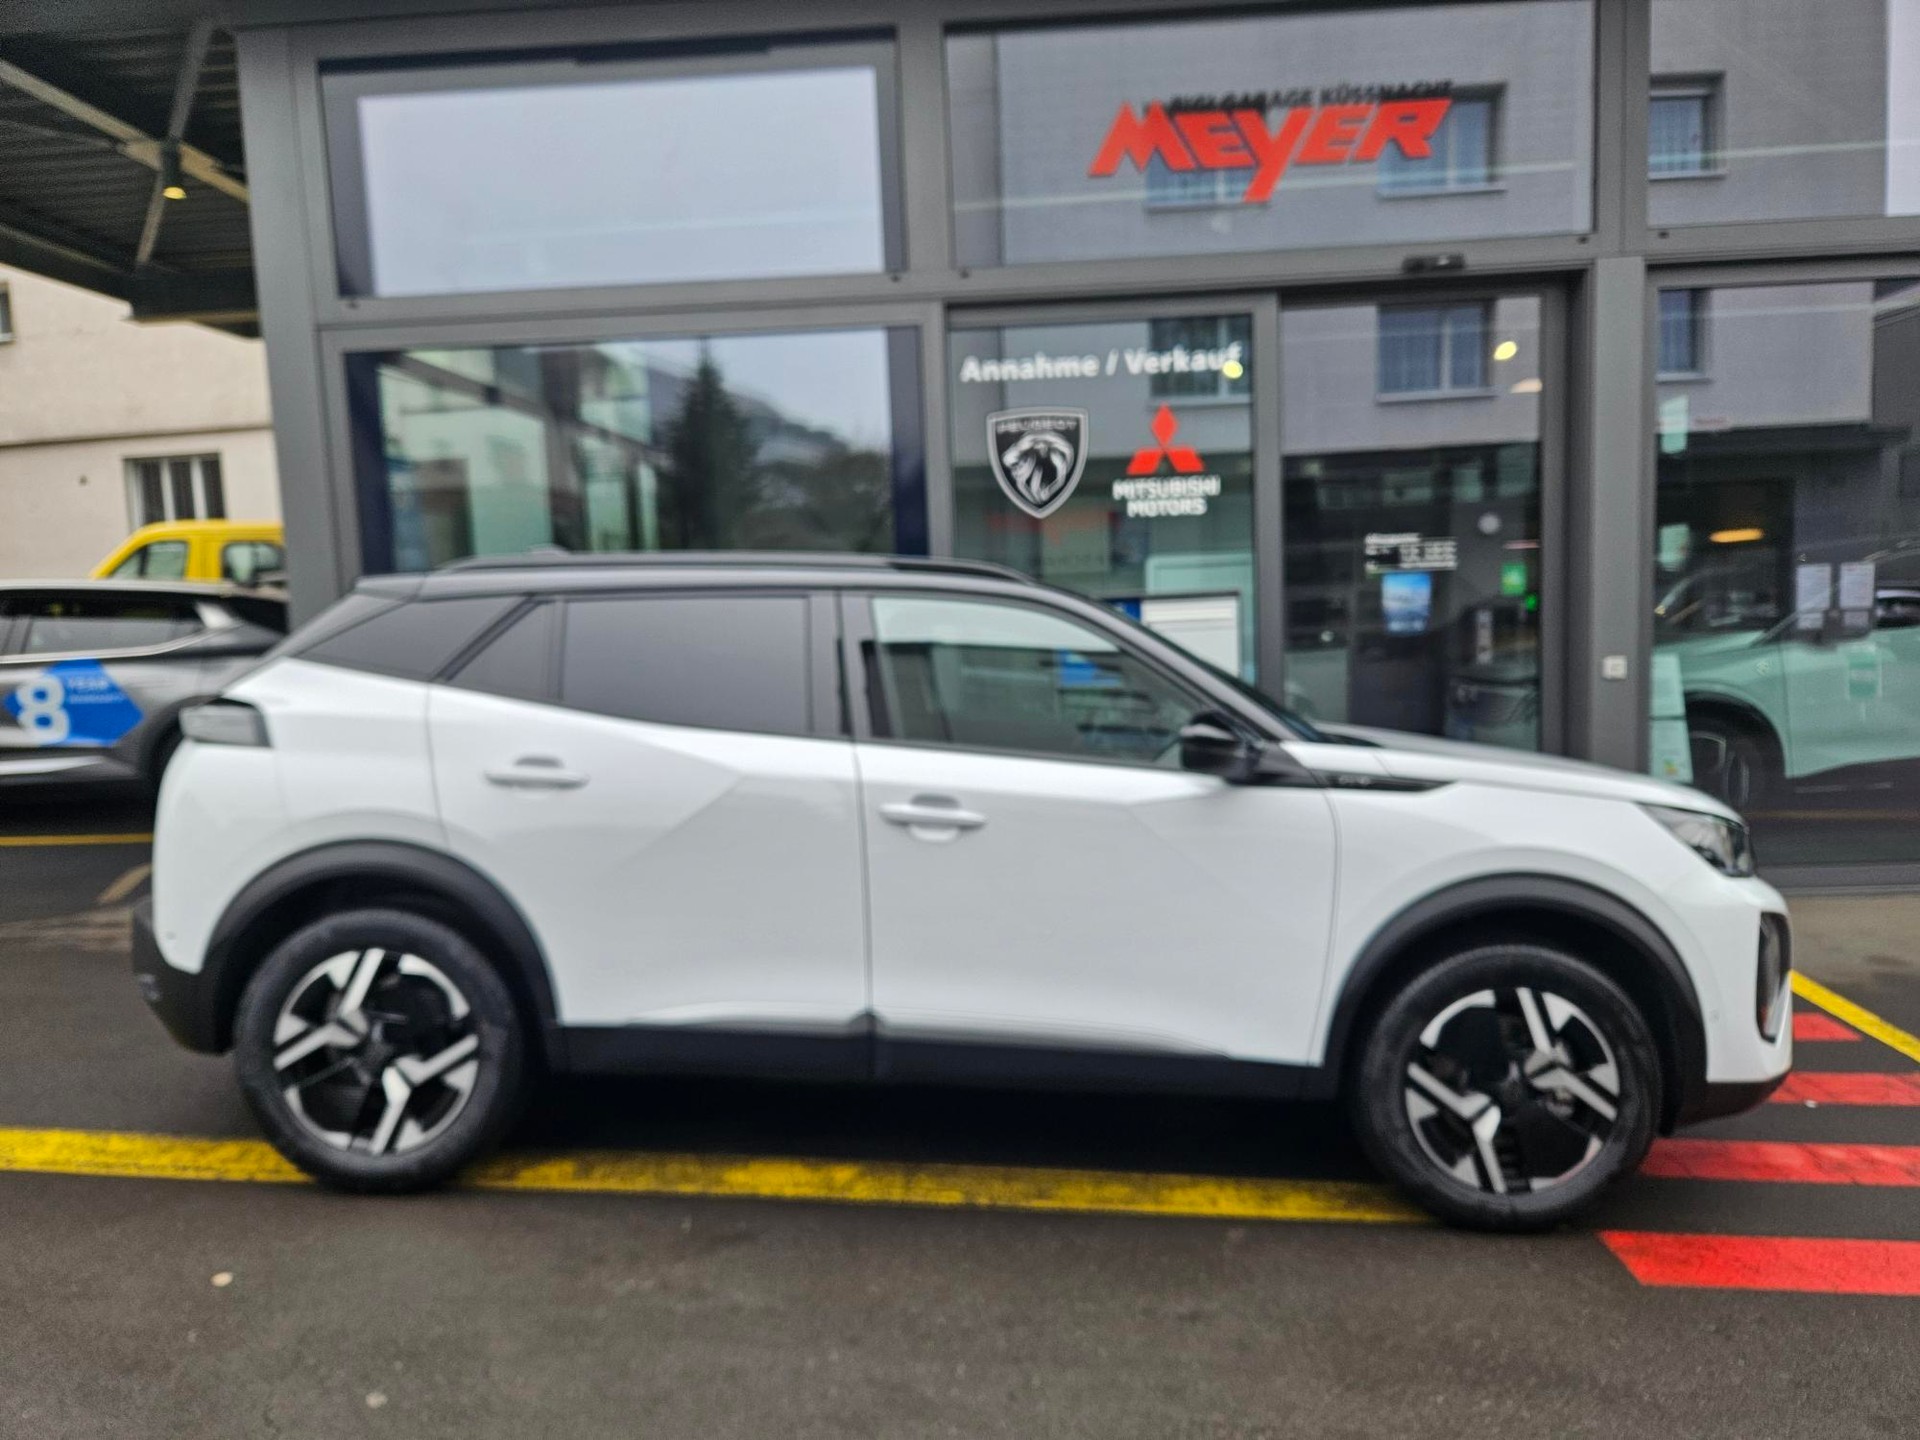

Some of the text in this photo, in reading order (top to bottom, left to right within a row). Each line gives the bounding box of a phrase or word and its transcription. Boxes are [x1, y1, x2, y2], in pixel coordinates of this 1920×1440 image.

[1088, 98, 1452, 203] MEYER
[960, 341, 1243, 382] Annahme / Verkauf
[1112, 475, 1222, 500] MITSUBISHI
[1127, 499, 1208, 518] MOTORS
[16, 673, 70, 744] 8
